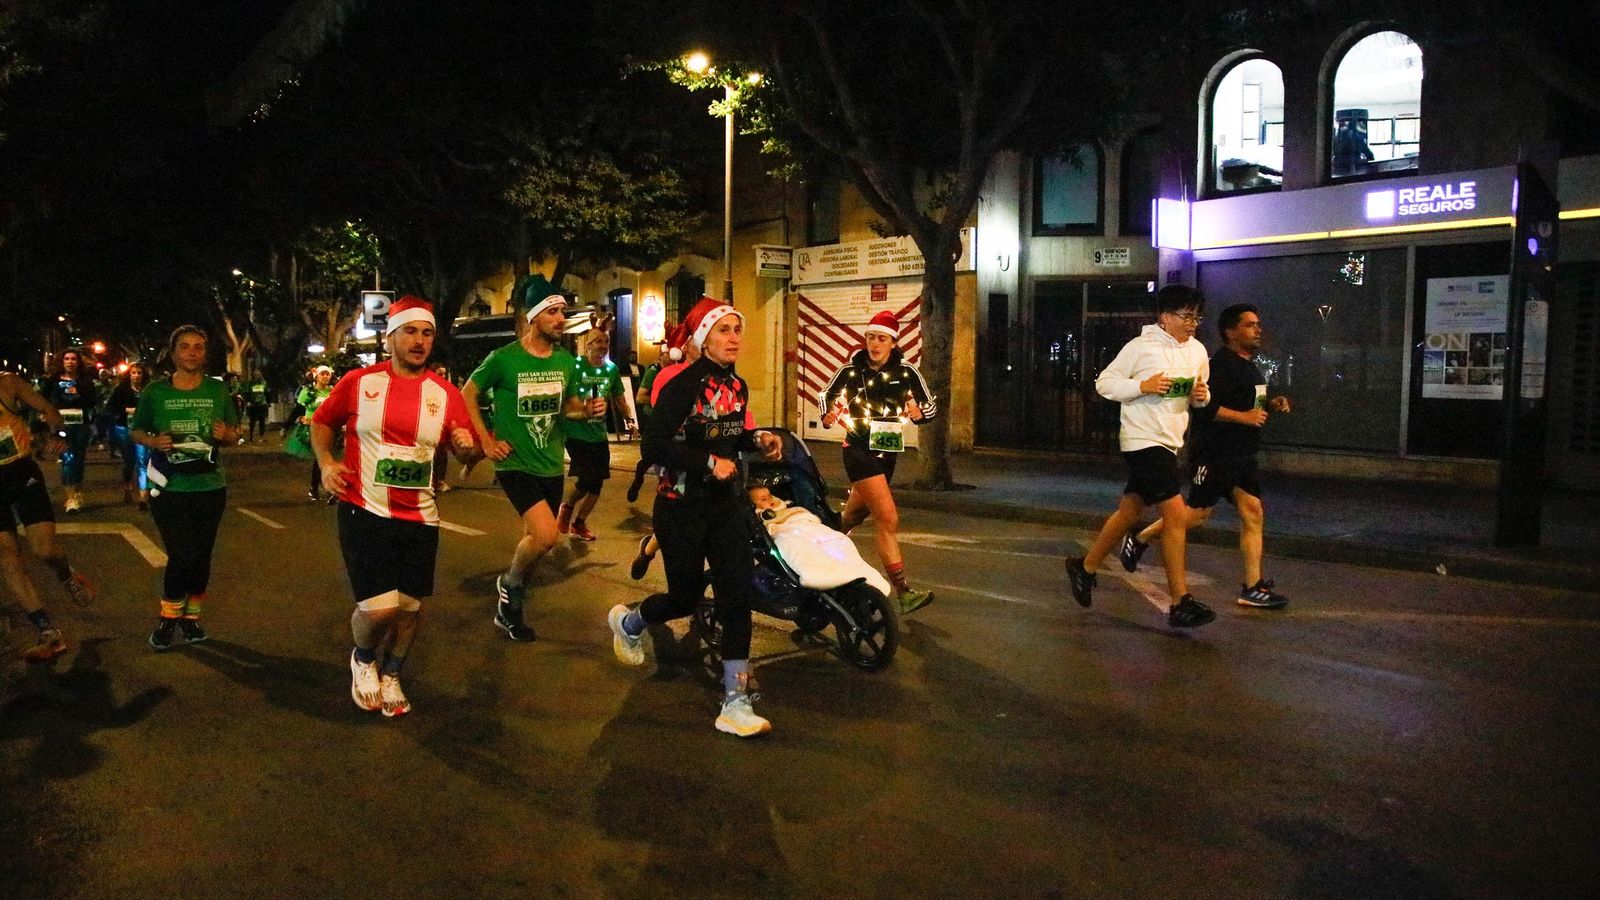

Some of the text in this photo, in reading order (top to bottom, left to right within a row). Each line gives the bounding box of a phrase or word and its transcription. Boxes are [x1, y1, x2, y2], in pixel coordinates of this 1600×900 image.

[1399, 182, 1476, 204] REALE
[1398, 198, 1476, 216] SEGUROS
[1095, 251, 1101, 263] 9
[522, 398, 557, 412] 1665
[877, 437, 899, 447] 453
[384, 466, 422, 482] 454
